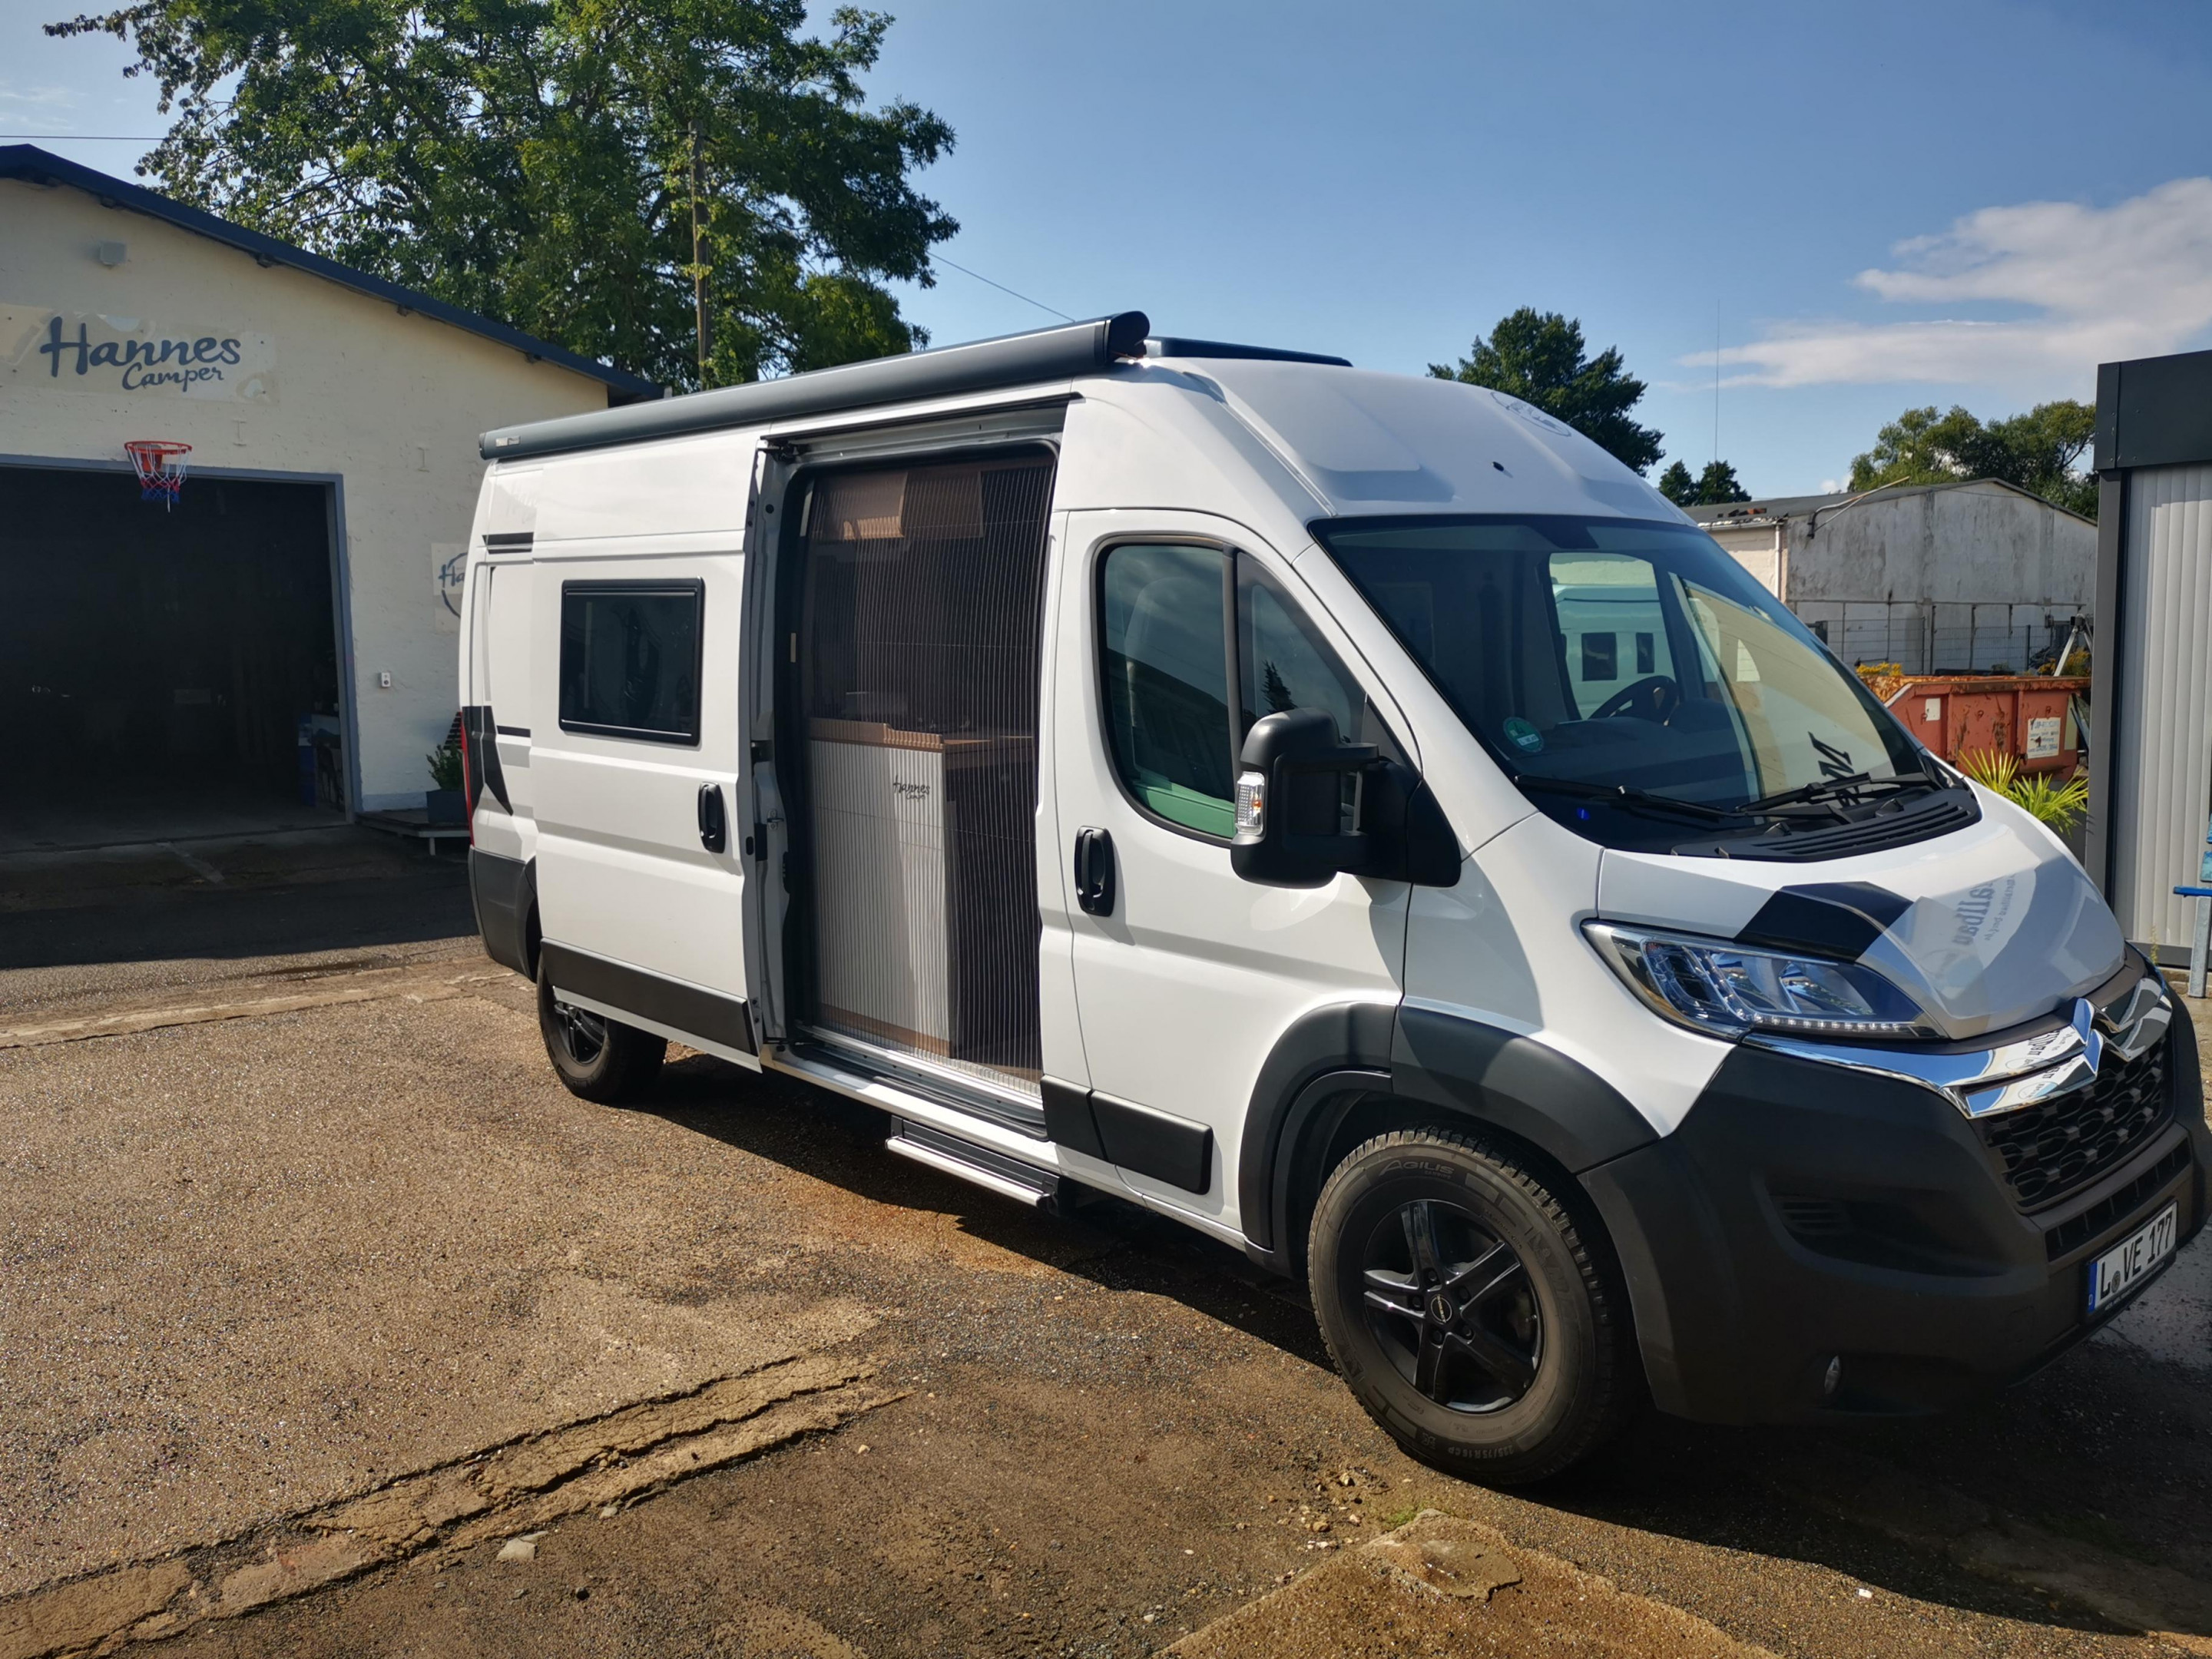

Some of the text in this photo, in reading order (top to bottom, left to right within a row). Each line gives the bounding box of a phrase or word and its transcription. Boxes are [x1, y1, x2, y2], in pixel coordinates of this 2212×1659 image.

[40, 316, 241, 377] Hannes
[121, 362, 225, 392] Camper
[892, 774, 931, 795] Hannes
[1379, 1160, 1455, 1176] AGILIS
[2124, 1236, 2143, 1282] VE
[2147, 1211, 2173, 1264] 177
